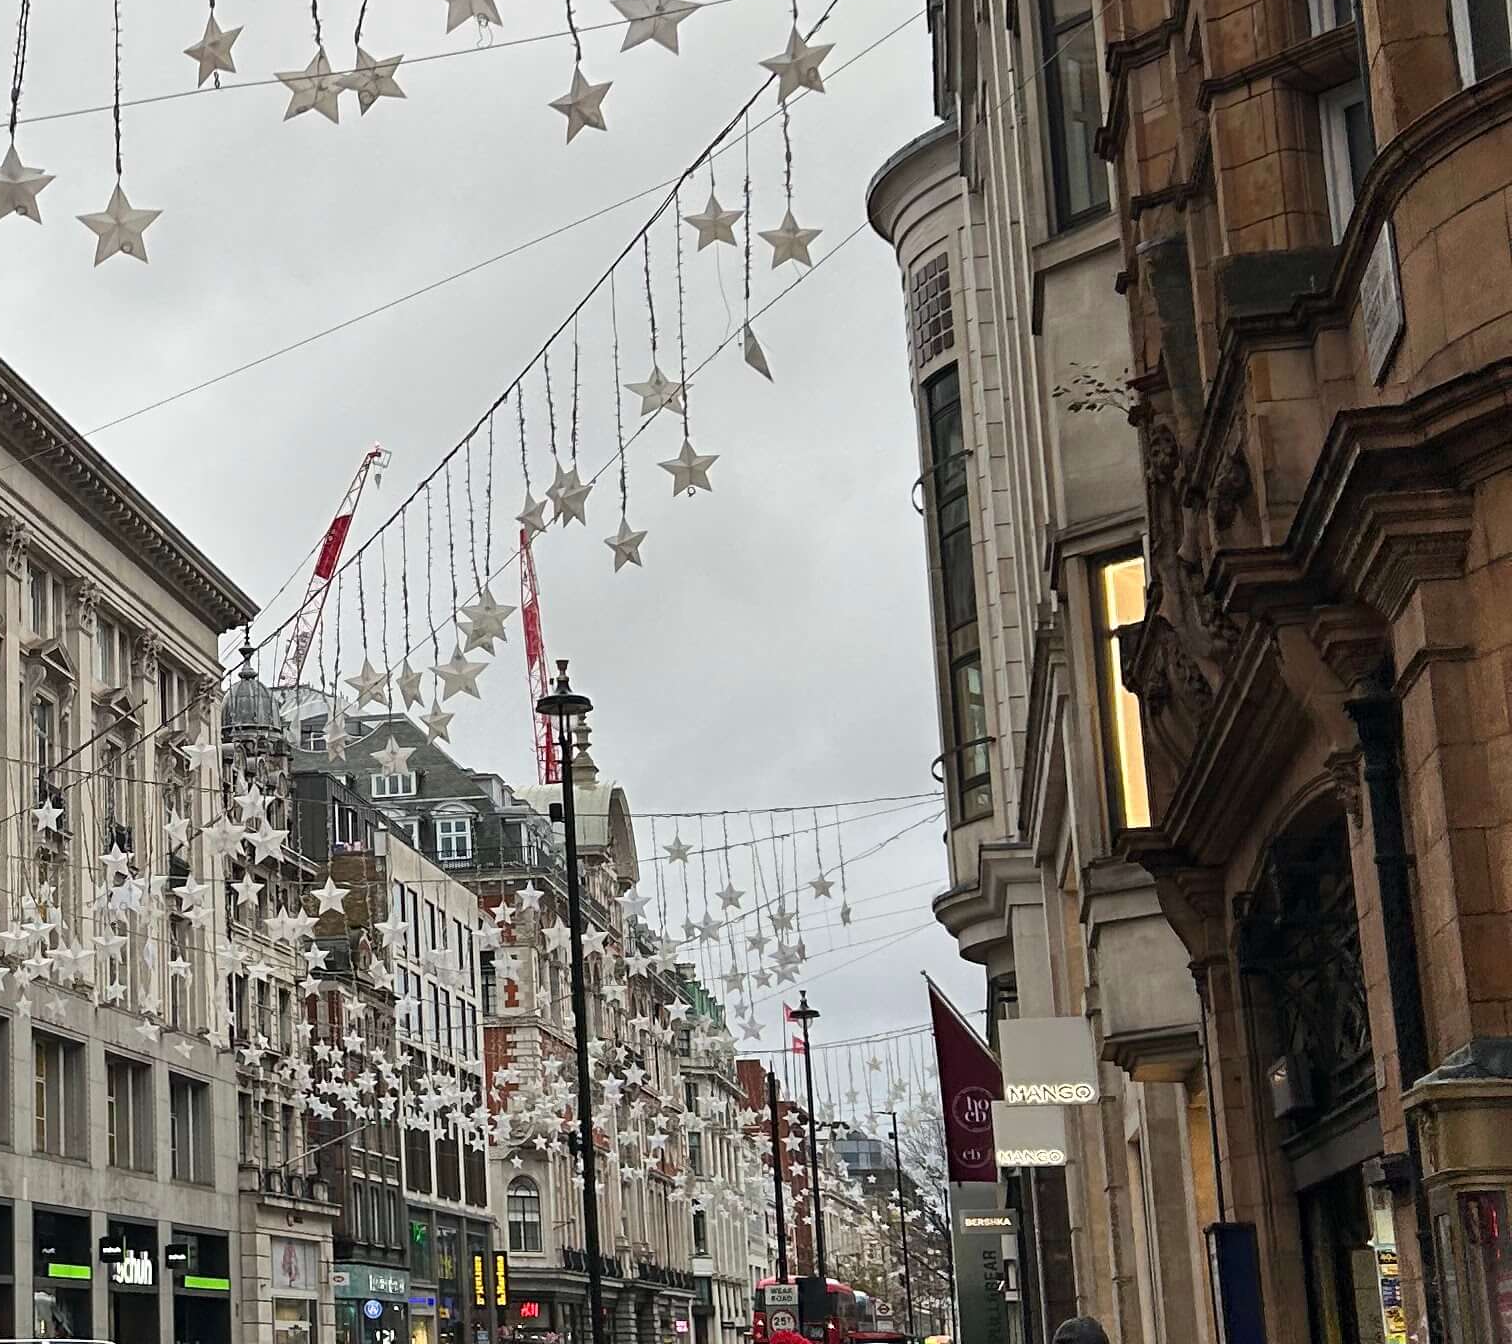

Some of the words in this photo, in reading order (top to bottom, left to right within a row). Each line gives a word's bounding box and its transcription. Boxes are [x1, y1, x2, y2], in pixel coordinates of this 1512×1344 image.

[1008, 1084, 1092, 1103] MANGO
[998, 1149, 1064, 1163] MANGO
[964, 1217, 1011, 1227] BERSHKA
[770, 1287, 792, 1295] WEAK
